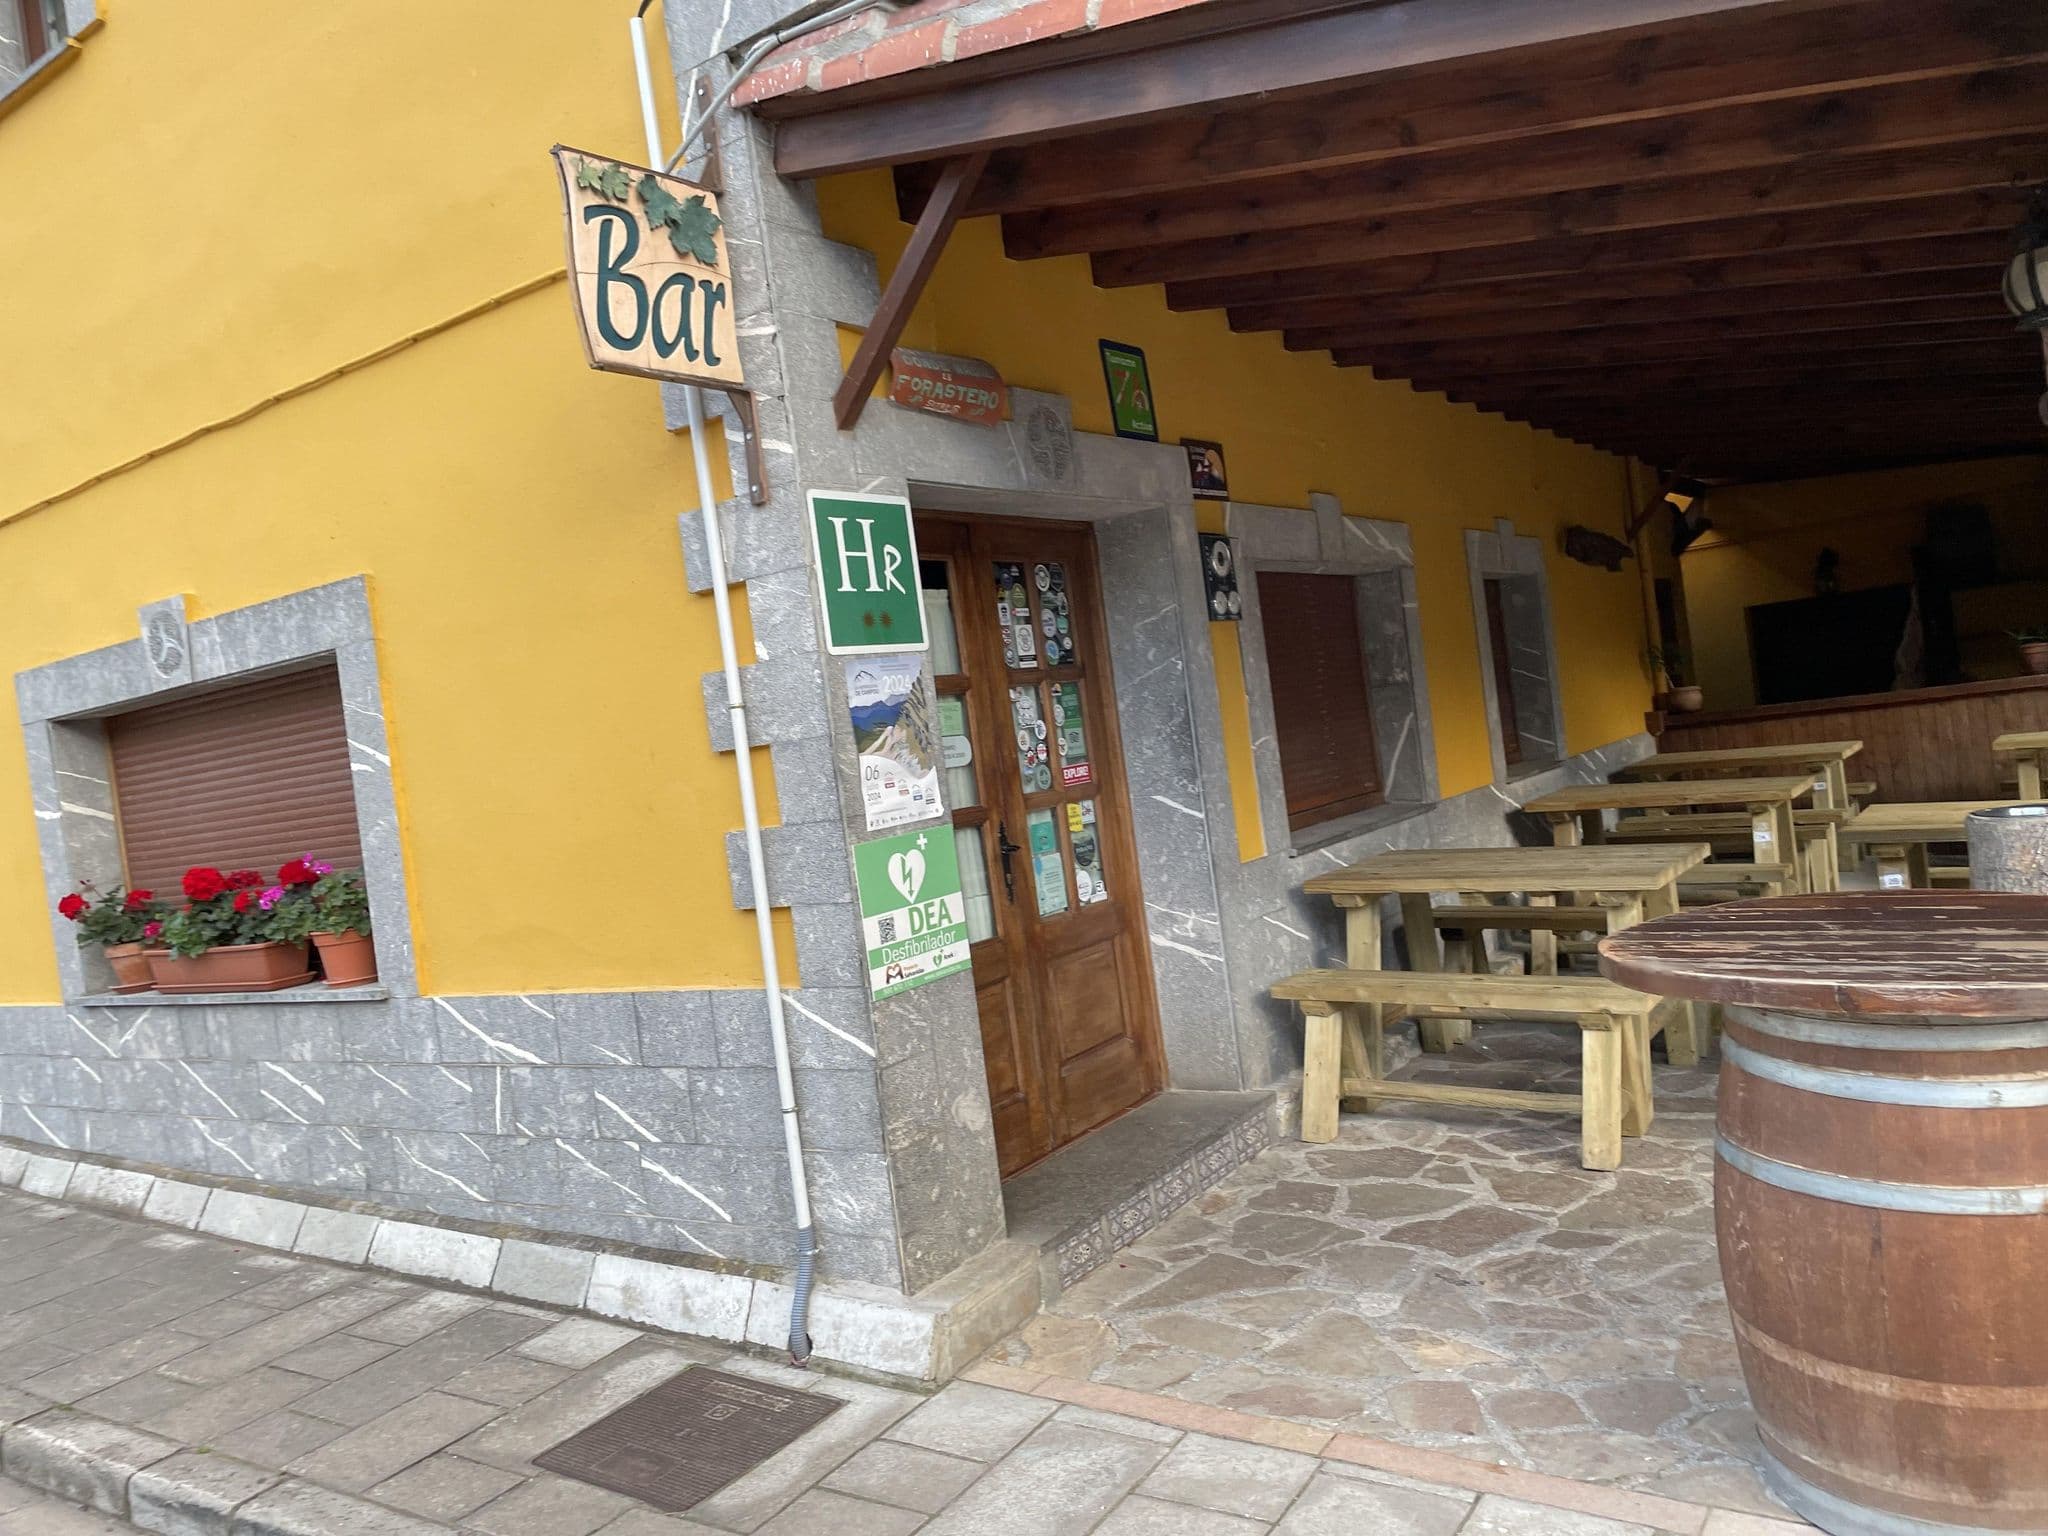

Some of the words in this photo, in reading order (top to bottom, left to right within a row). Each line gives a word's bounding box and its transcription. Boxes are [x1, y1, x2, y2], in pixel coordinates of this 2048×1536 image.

[583, 204, 726, 367] Bar
[896, 374, 1000, 409] FORASTERO
[865, 764, 880, 781] 06
[908, 898, 953, 936] DEA
[881, 930, 957, 965] Desfibrilador
